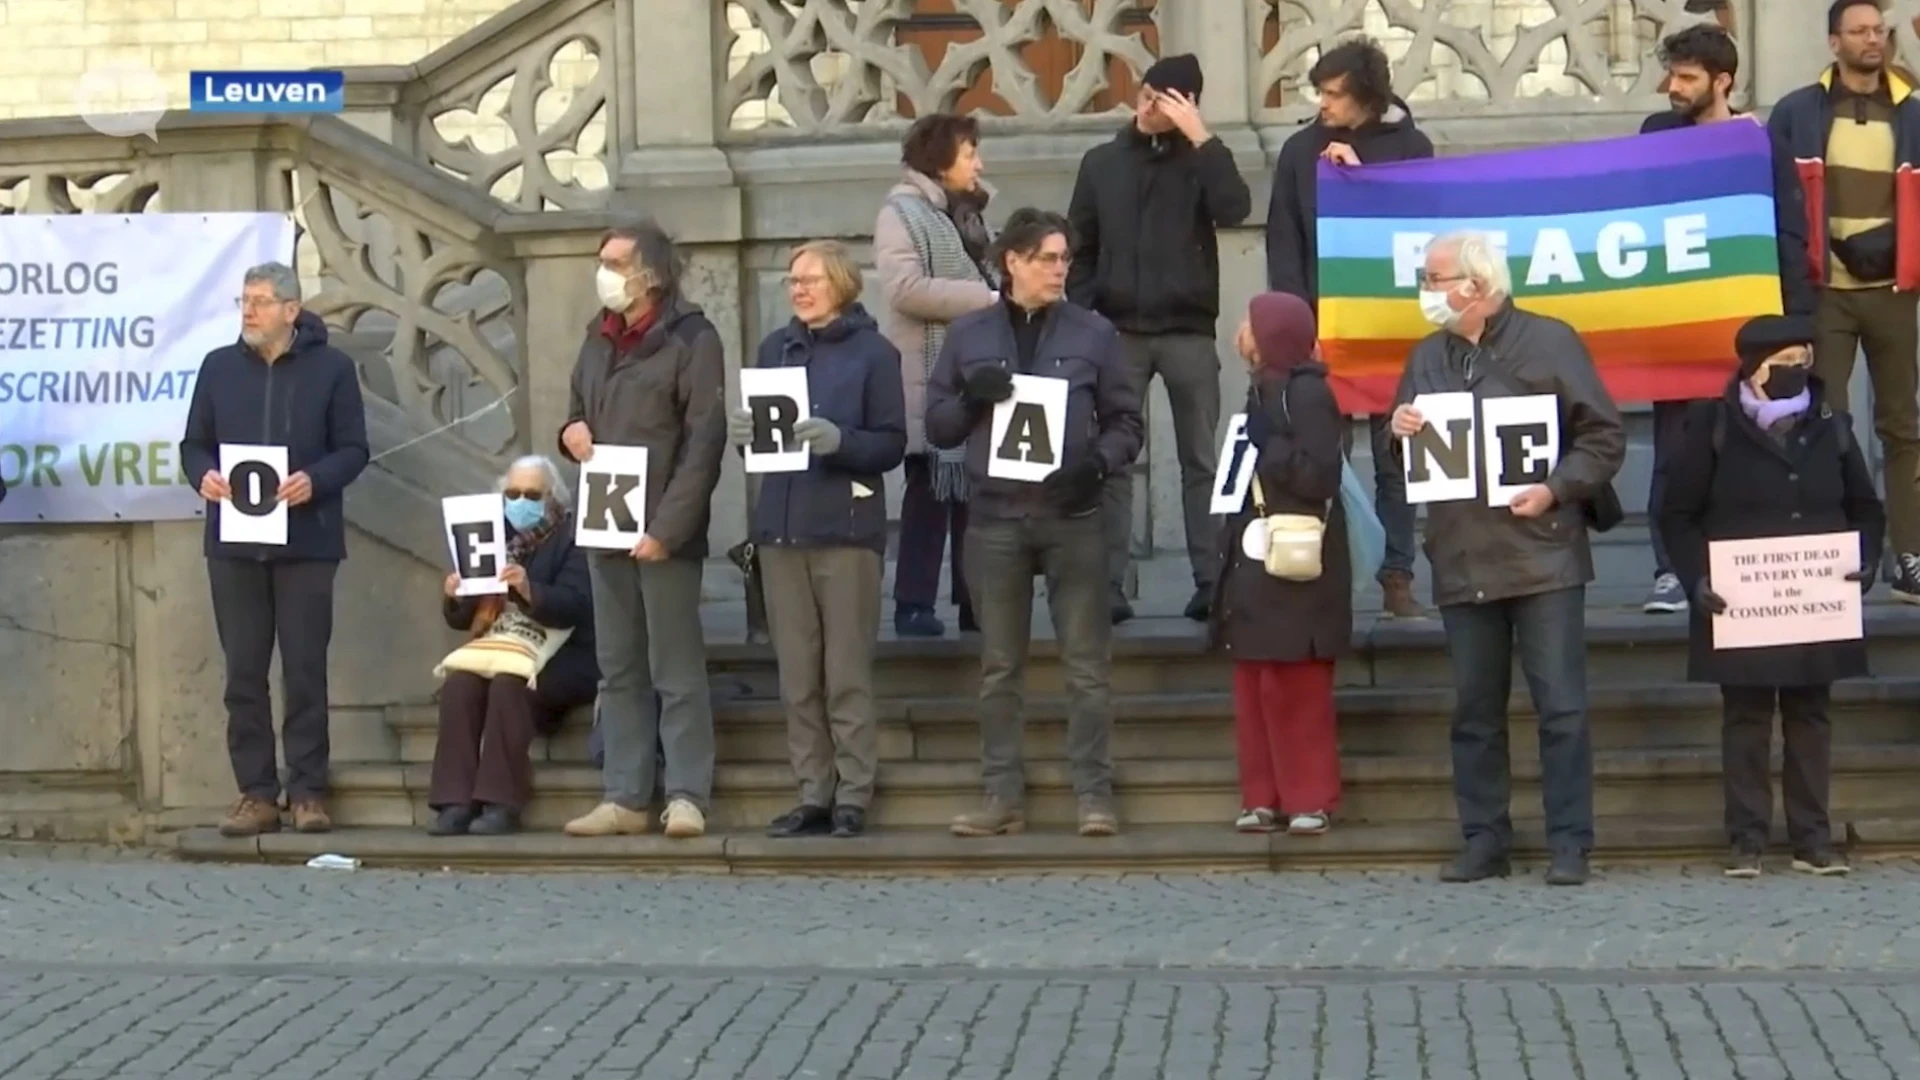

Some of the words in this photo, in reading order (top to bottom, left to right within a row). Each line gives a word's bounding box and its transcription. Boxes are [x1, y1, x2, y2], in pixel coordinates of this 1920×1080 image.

[1392, 213, 1711, 288] PACE
[749, 395, 804, 454] R
[997, 403, 1055, 465] A
[1408, 418, 1473, 484] N
[1496, 422, 1549, 486] E
[80, 442, 189, 488] VRE
[229, 460, 280, 517] O
[582, 472, 640, 533] K
[452, 521, 497, 580] E
[1733, 554, 1760, 566] THE
[1763, 551, 1800, 564] FIRST
[1803, 548, 1840, 561] DEAD
[1740, 572, 1752, 583] in
[1754, 570, 1800, 582] EVERY
[1802, 567, 1833, 578] WAR
[1729, 605, 1800, 619] COMMON
[1802, 600, 1847, 614] SENSE
[1773, 588, 1782, 598] is
[1785, 587, 1802, 598] the
